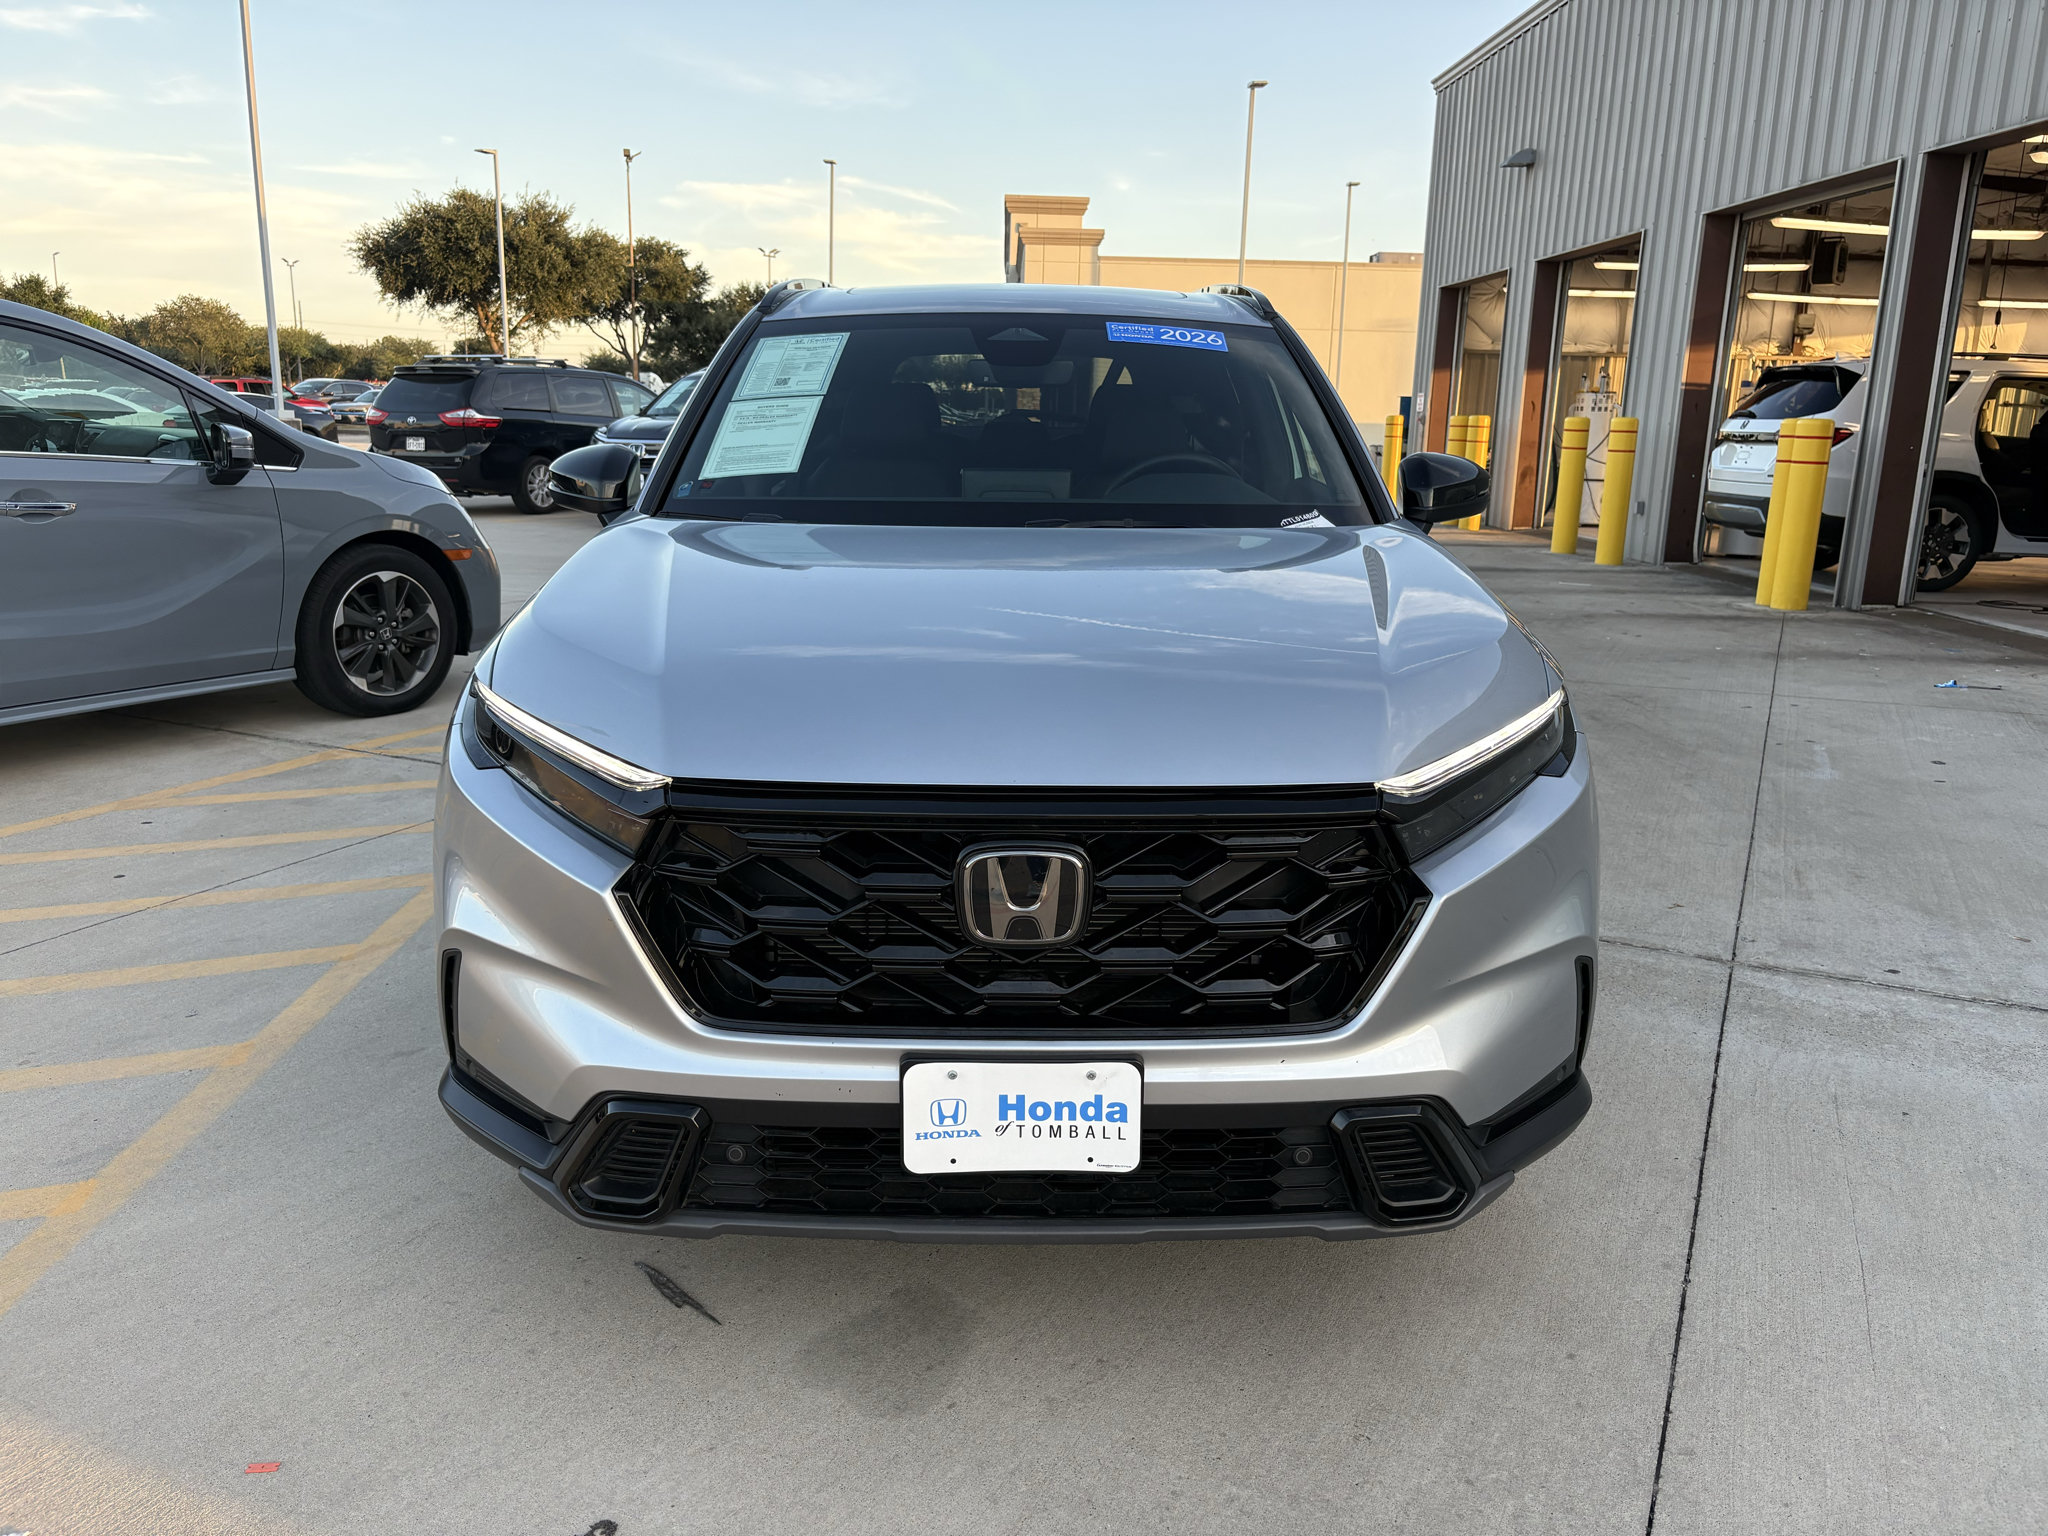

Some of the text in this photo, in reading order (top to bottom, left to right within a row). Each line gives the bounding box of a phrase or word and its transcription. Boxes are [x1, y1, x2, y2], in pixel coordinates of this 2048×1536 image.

[1159, 328, 1223, 346] 2026
[998, 1094, 1129, 1123] Honda
[914, 1129, 982, 1141] HONDA
[994, 1120, 1127, 1141] of TOMBALL
